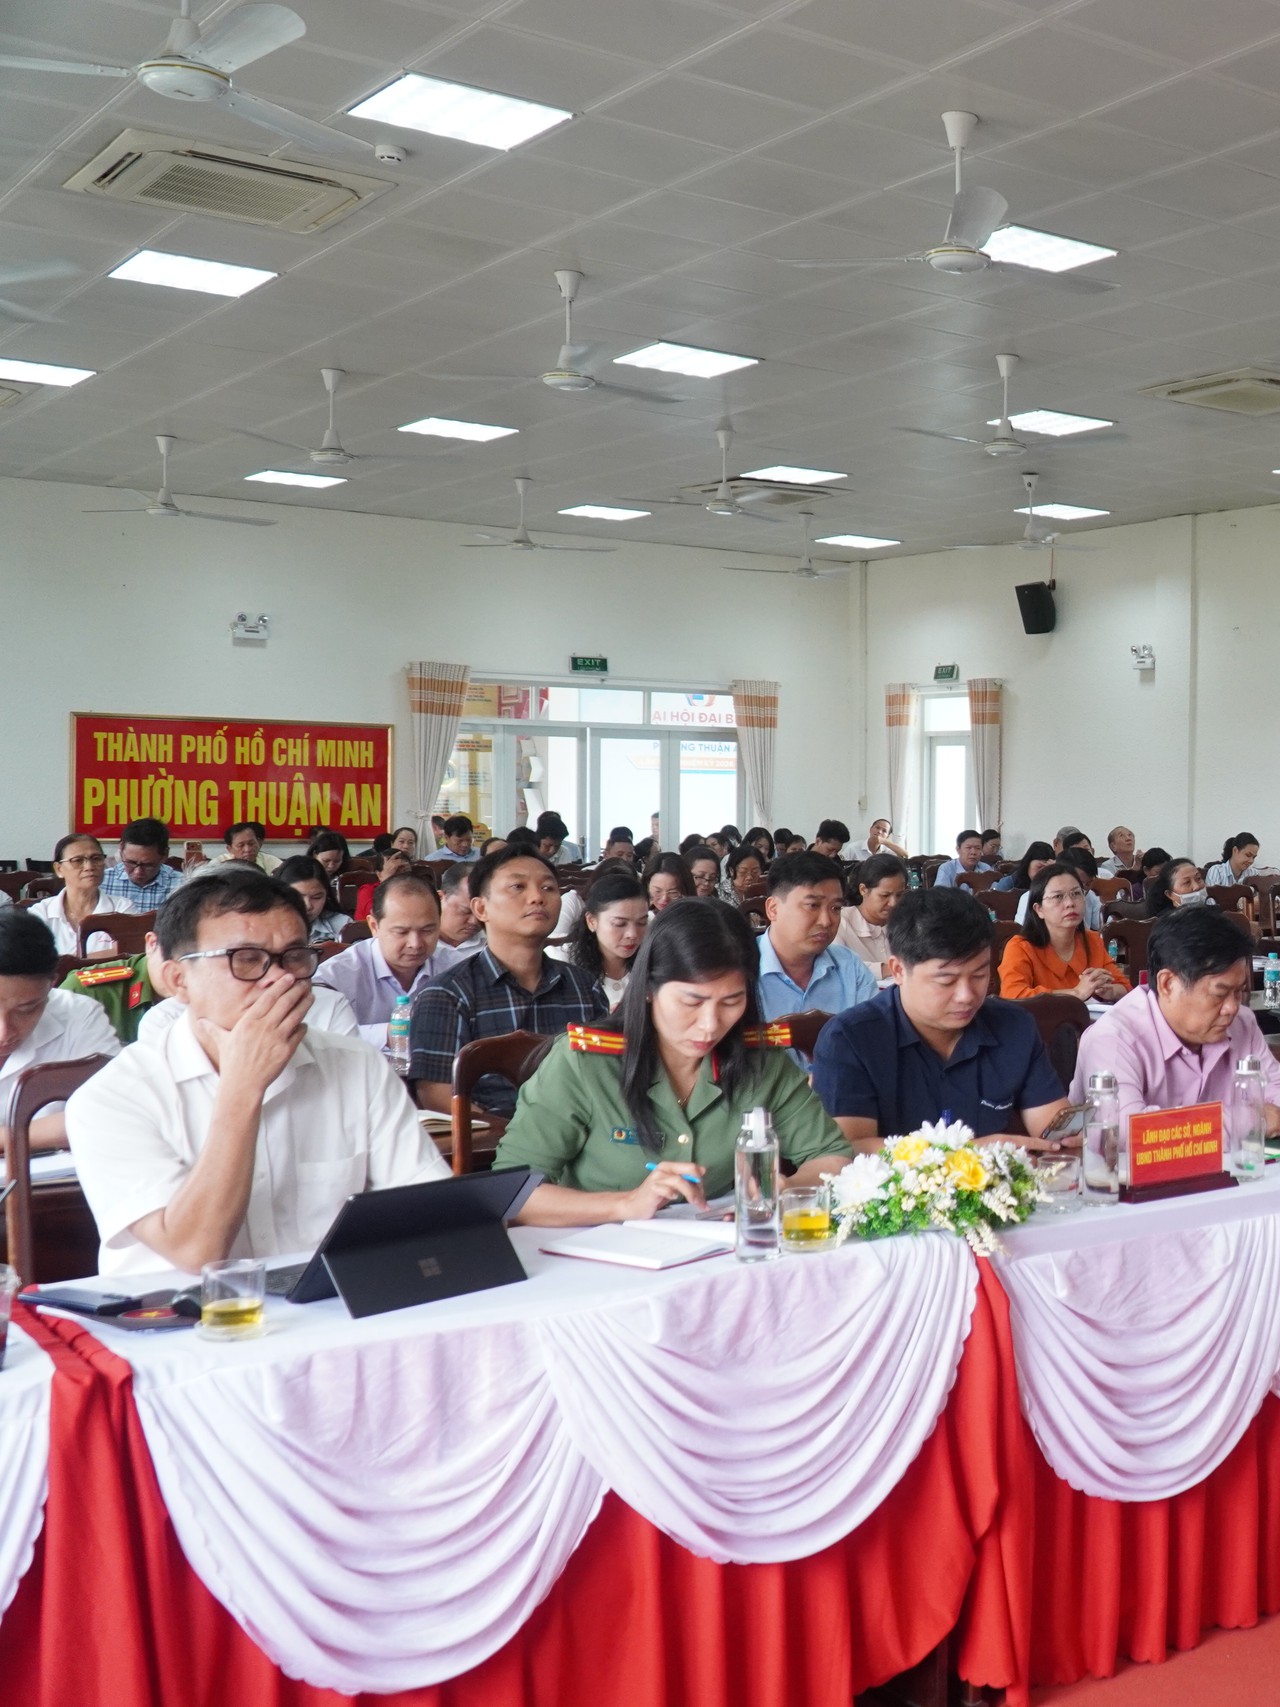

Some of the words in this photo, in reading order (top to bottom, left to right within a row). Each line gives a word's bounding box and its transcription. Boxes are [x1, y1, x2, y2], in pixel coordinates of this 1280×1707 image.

[577, 658, 600, 666] EXIT
[94, 727, 173, 763] THÀNH
[181, 726, 228, 765] PHỐ
[235, 727, 265, 766] HỒ
[272, 733, 309, 767] CHÍ
[317, 740, 374, 768] MINH
[84, 768, 218, 825] PHƯỜNG
[229, 772, 331, 836] THUẬN
[340, 783, 381, 826] AN
[1143, 1129, 1158, 1144] LÃNH
[1158, 1128, 1170, 1143] ĐẠO
[1171, 1125, 1182, 1140] CÁC
[1193, 1121, 1212, 1137] NGÀNH
[1136, 1151, 1152, 1165] UBND
[1153, 1146, 1172, 1163] THÀNH
[1173, 1142, 1184, 1159] PHỐ
[1185, 1141, 1193, 1157] HỒ
[1193, 1140, 1203, 1155] CHÍ
[1203, 1140, 1218, 1154] MINH
